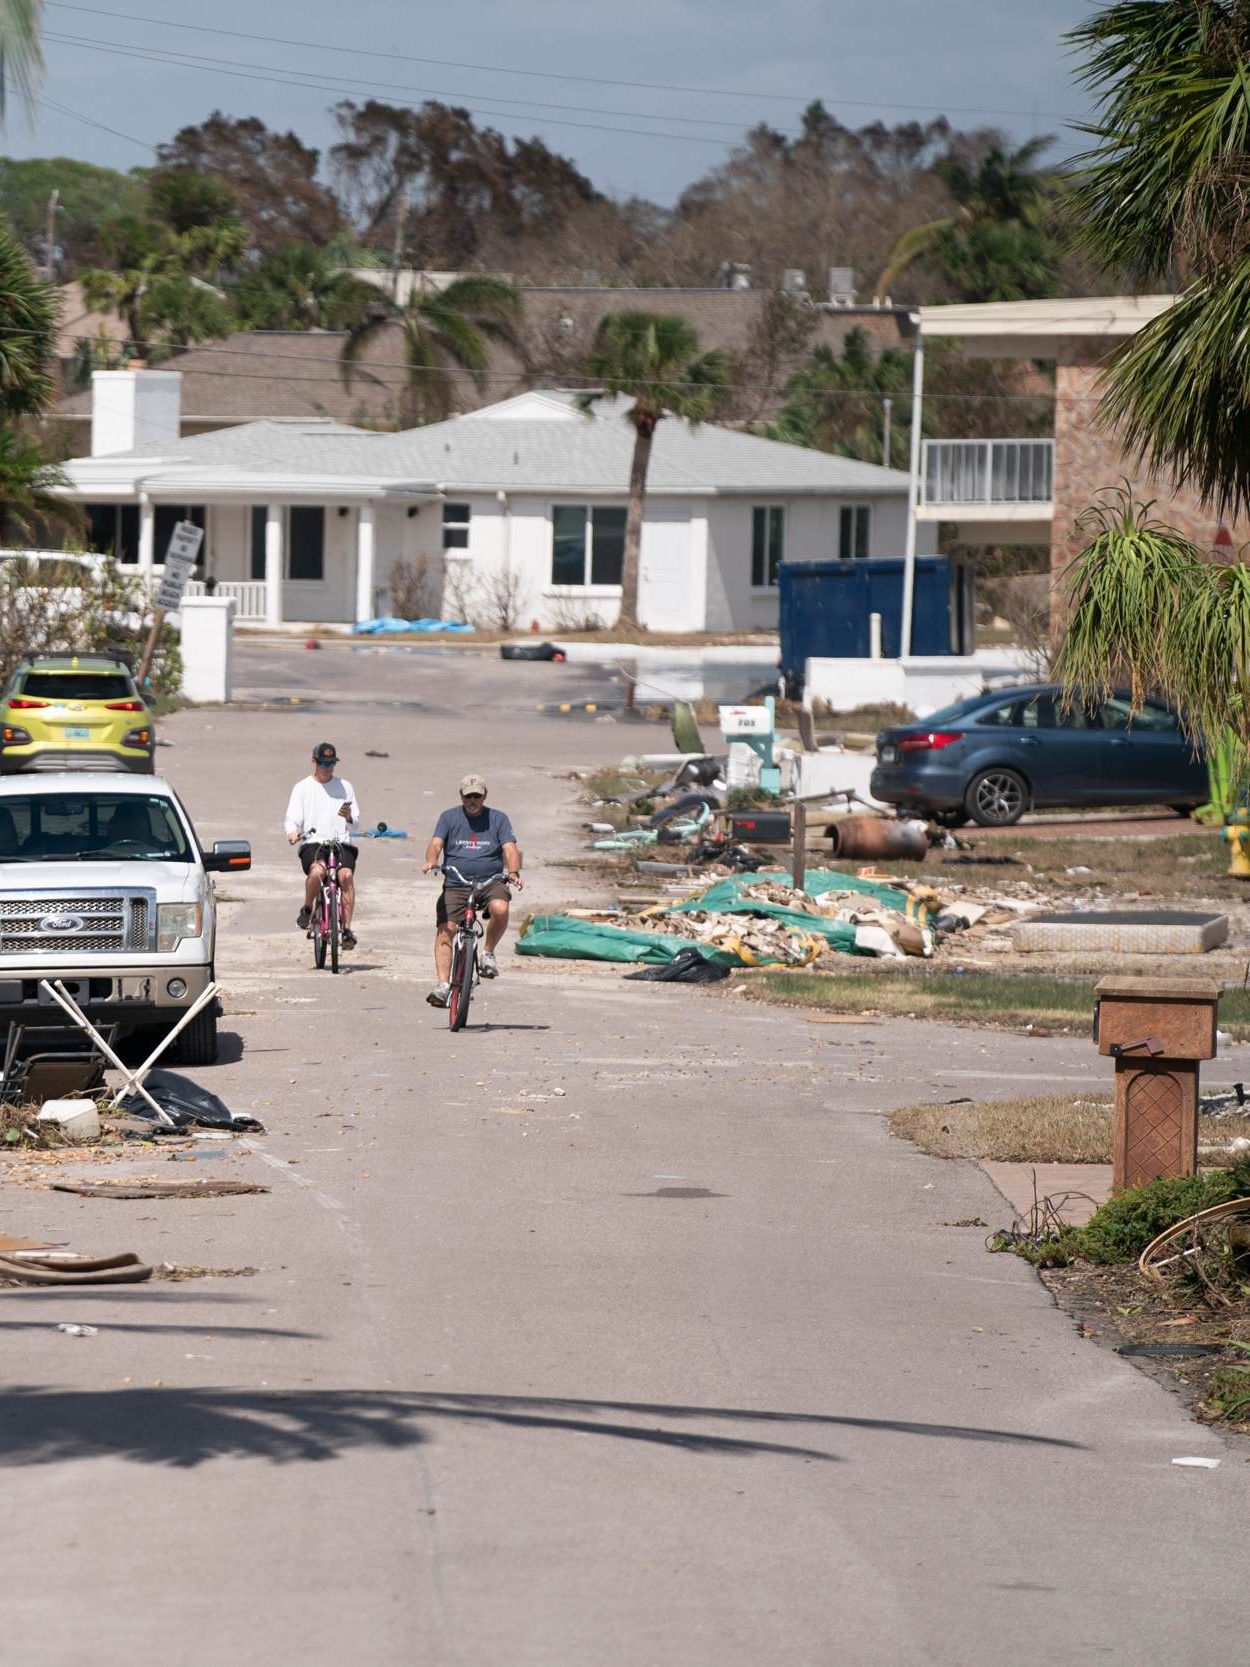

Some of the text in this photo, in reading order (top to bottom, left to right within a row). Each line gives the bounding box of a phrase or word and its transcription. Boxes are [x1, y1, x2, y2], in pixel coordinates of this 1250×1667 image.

[163, 579, 184, 589] PUBLIC
[161, 588, 180, 599] BEACH
[157, 598, 179, 609] ACCESS
[52, 919, 72, 928] Ford
